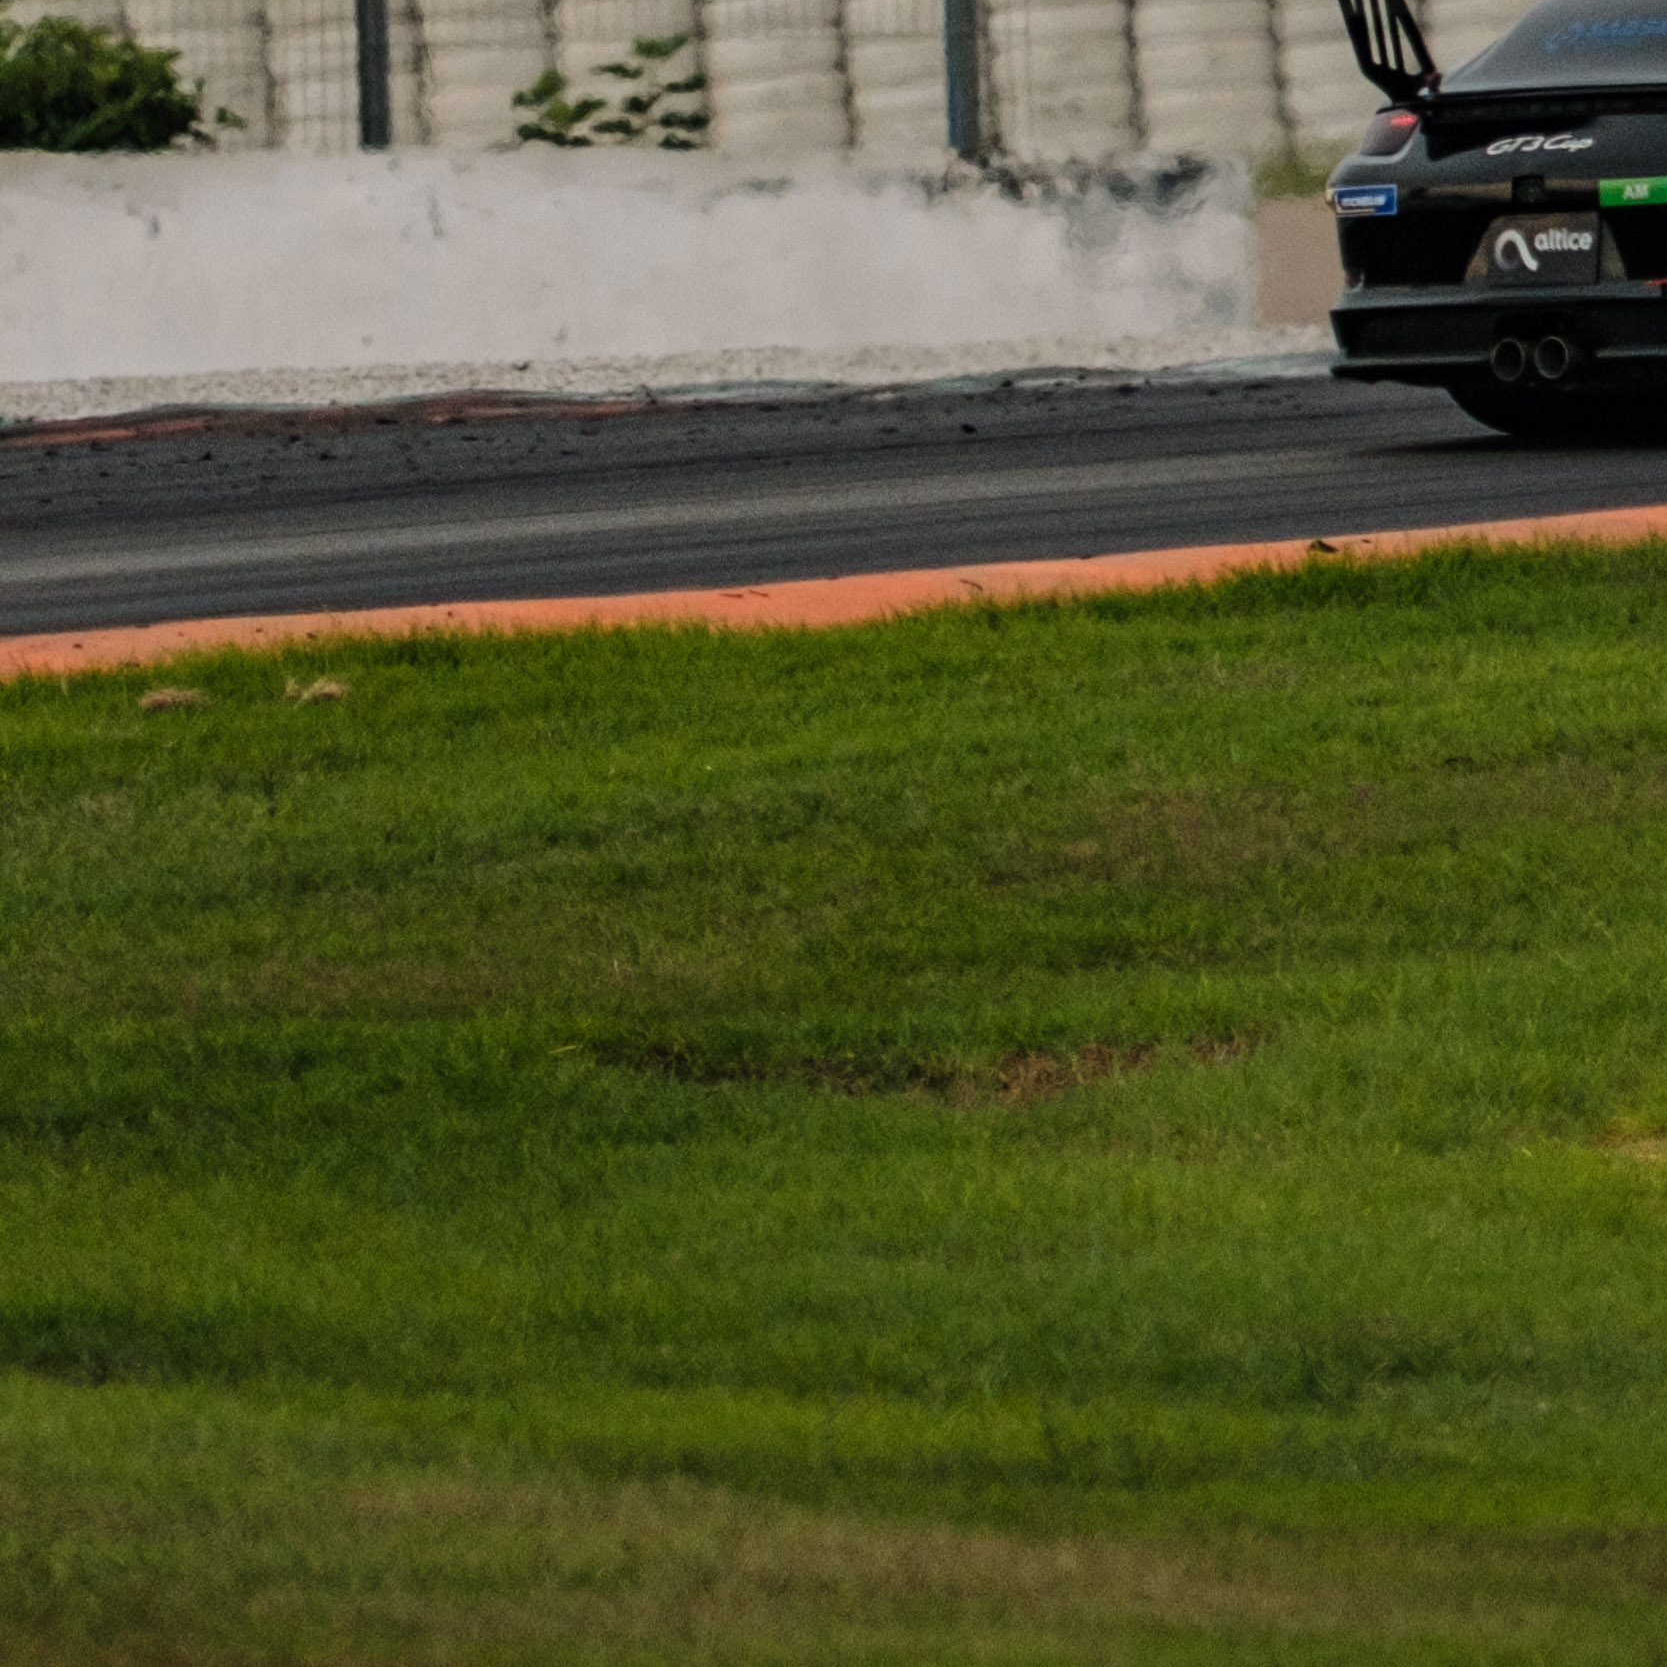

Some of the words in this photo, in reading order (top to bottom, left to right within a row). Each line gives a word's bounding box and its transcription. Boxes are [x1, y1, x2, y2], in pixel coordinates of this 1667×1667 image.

[1486, 135, 1544, 155] GT3
[1622, 183, 1650, 200] AM
[1534, 228, 1592, 252] altice
